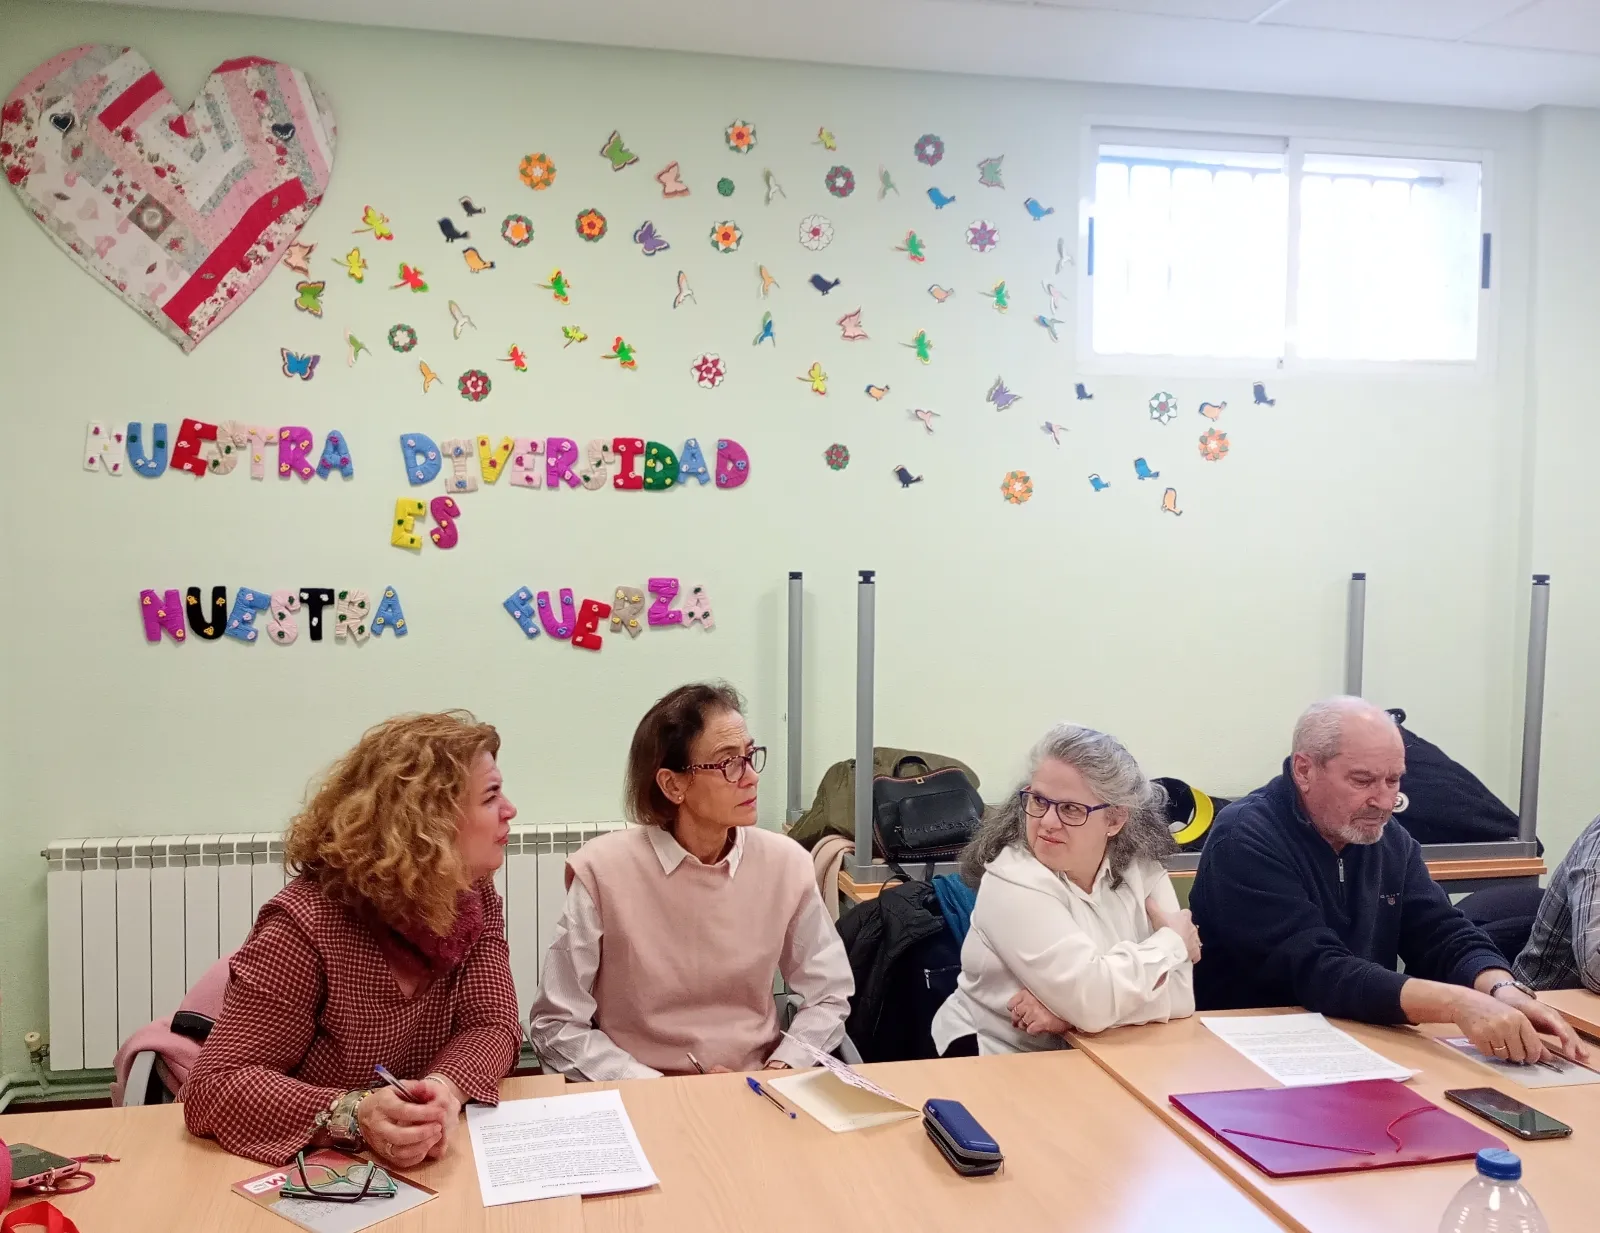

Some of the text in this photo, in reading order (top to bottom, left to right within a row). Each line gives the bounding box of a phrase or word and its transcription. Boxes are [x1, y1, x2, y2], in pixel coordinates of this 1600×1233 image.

[84, 418, 750, 493] NUESTRA DIVERSIDAD
[391, 496, 461, 550] ES
[140, 578, 716, 650] NUESTRA FUERZA
